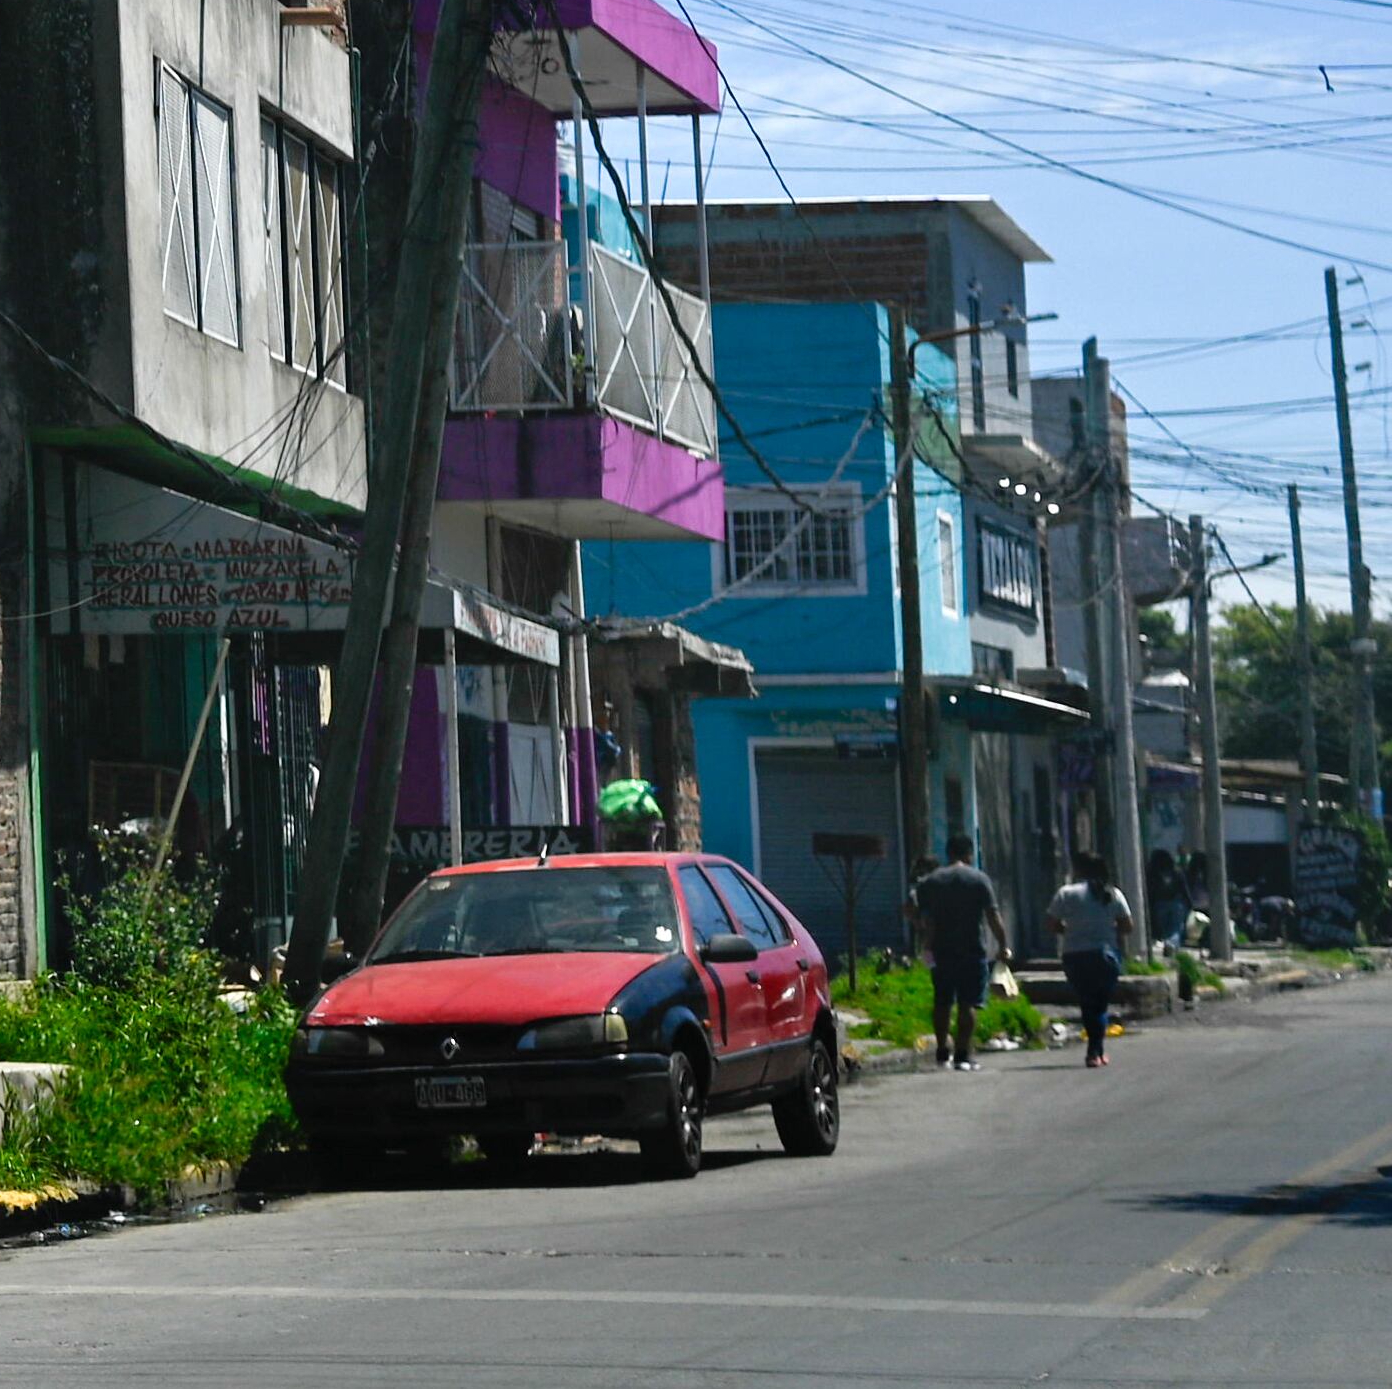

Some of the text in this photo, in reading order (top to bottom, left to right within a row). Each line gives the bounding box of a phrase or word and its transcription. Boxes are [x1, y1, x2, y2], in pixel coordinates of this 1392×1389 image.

[194, 536, 307, 559] MARGARINA
[154, 608, 290, 629] QUESO AZUL
